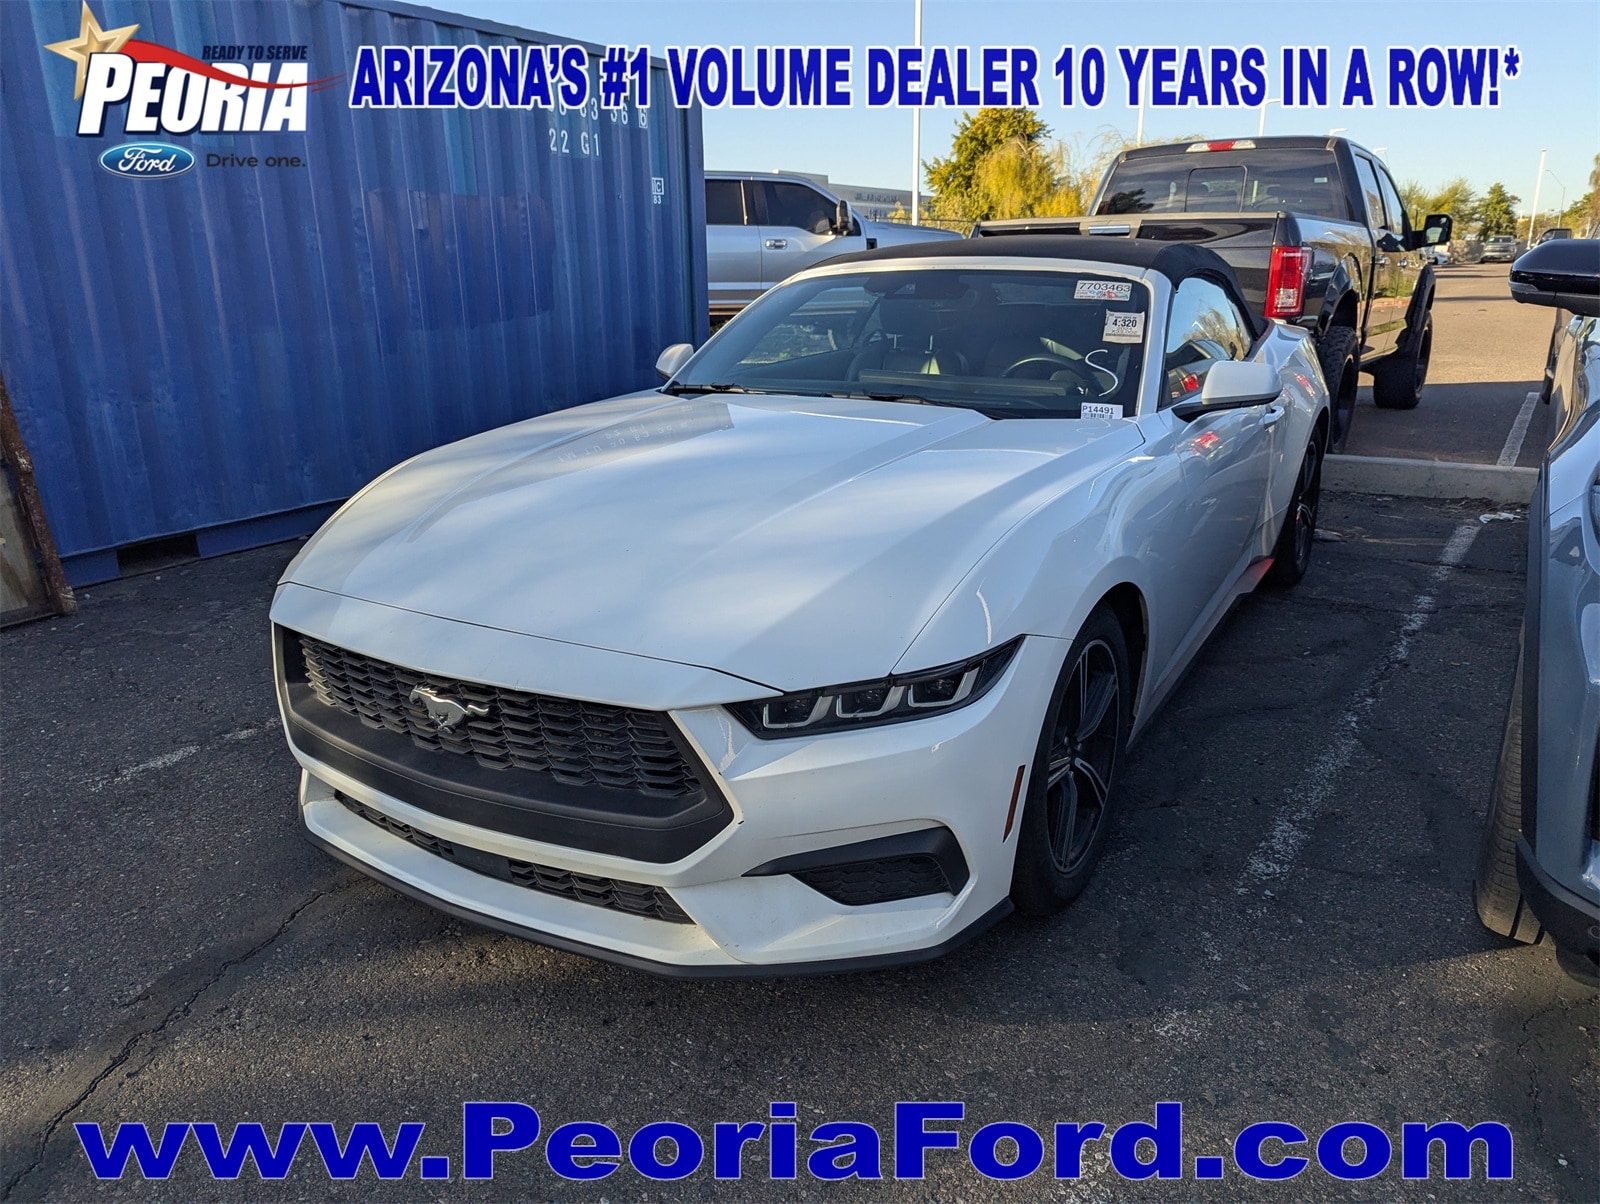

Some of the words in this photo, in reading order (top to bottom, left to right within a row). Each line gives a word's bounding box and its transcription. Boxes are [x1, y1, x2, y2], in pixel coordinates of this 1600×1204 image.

[549, 129, 569, 153] 22
[581, 132, 599, 156] G1
[1080, 282, 1131, 293] 7703463
[1112, 319, 1137, 328] 4:320
[1082, 405, 1115, 415] P14491
